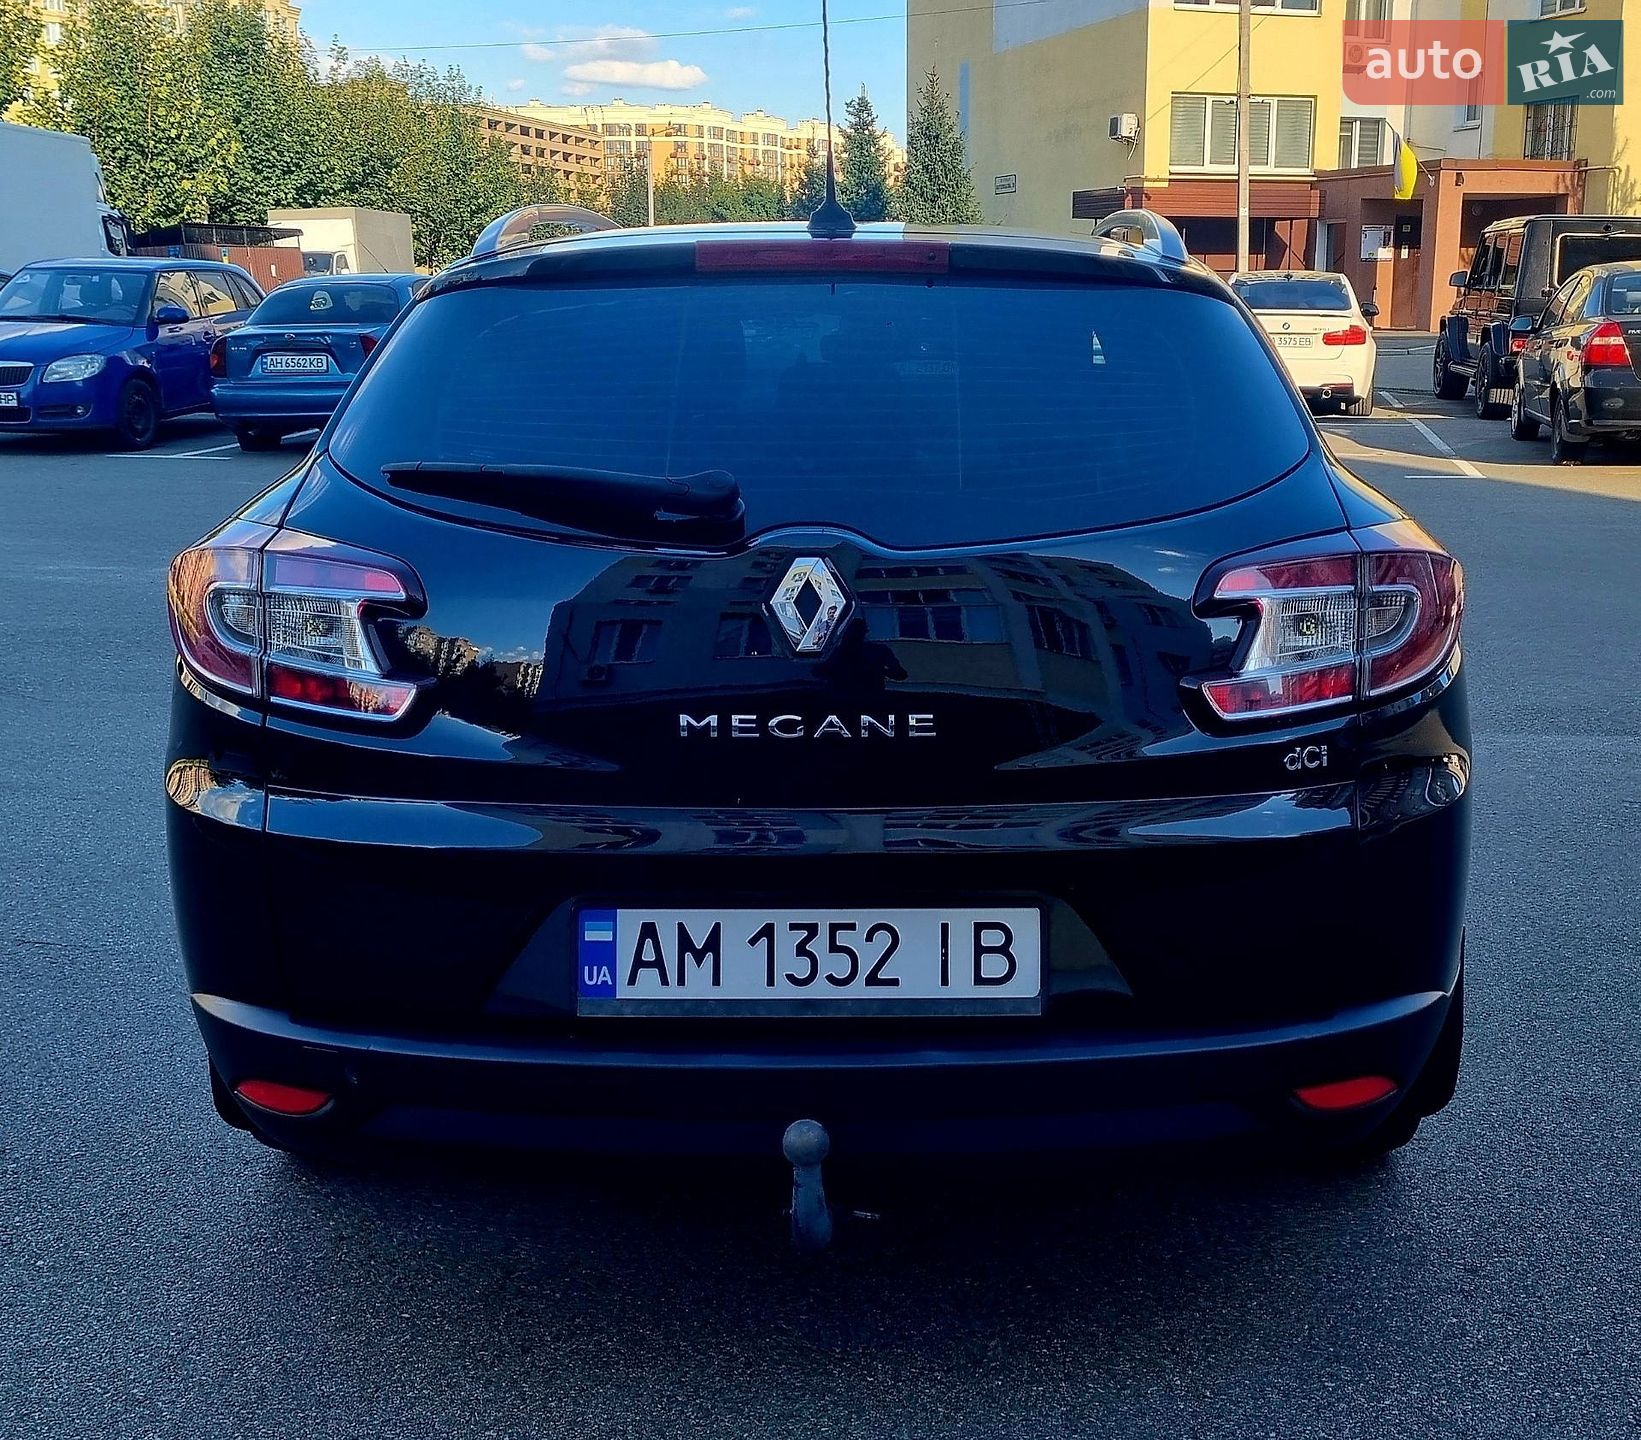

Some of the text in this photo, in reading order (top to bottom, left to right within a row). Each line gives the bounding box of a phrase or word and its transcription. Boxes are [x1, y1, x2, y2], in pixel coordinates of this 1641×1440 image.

[1278, 336, 1298, 346] 3575
[268, 357, 324, 369] AH 6562 KB
[680, 714, 936, 738] MEGANE
[1284, 745, 1328, 770] dCi
[626, 920, 1018, 988] AM 1352 IB
[584, 965, 612, 985] UA
